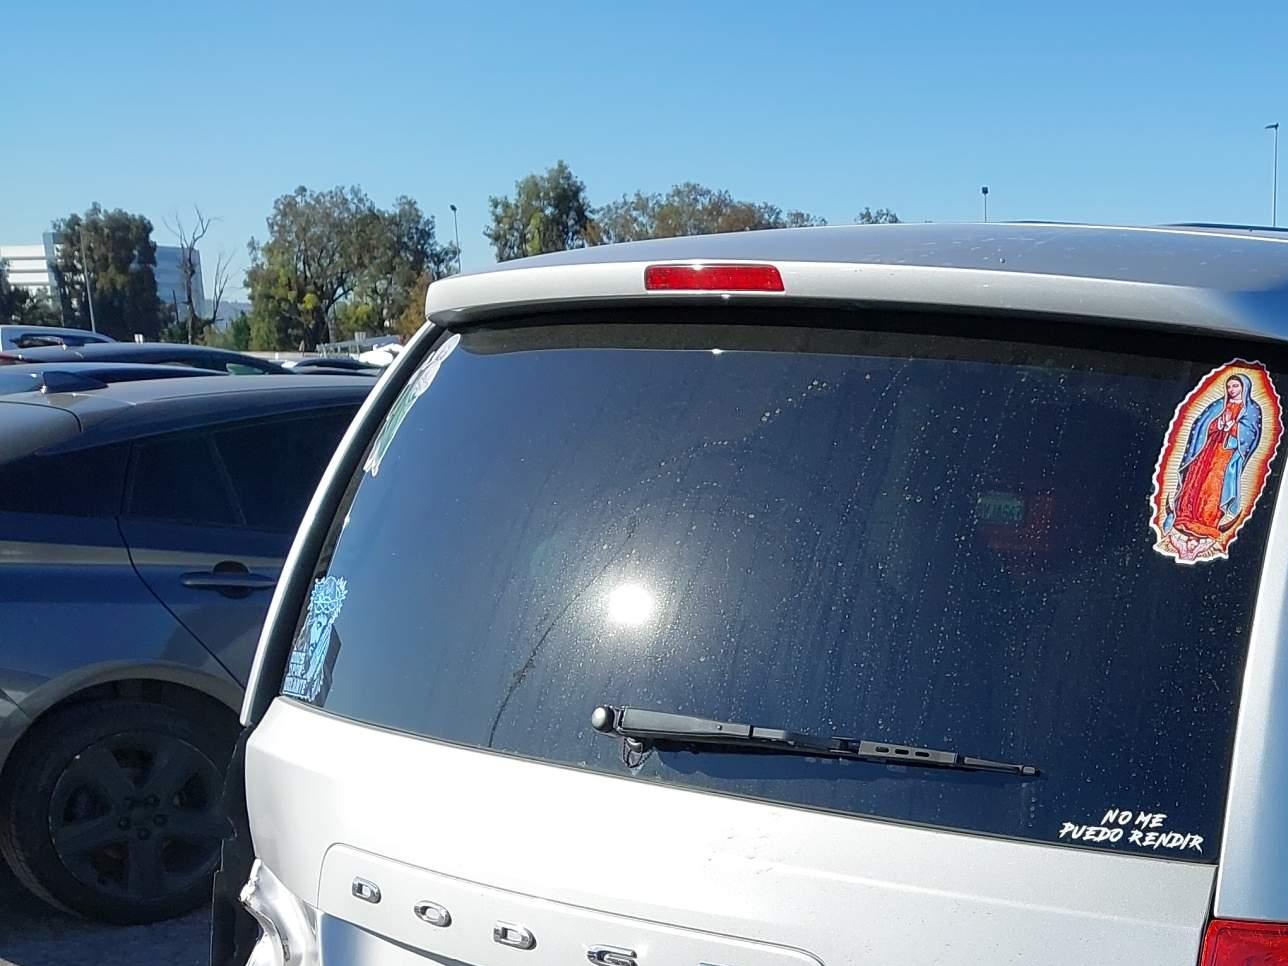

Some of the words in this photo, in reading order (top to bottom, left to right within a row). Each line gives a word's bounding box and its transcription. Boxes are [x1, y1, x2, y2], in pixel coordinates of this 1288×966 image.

[1101, 808, 1132, 826] NO
[1134, 811, 1167, 830] ME
[1058, 822, 1123, 842] PUEDO
[1128, 829, 1204, 854] RENDIR
